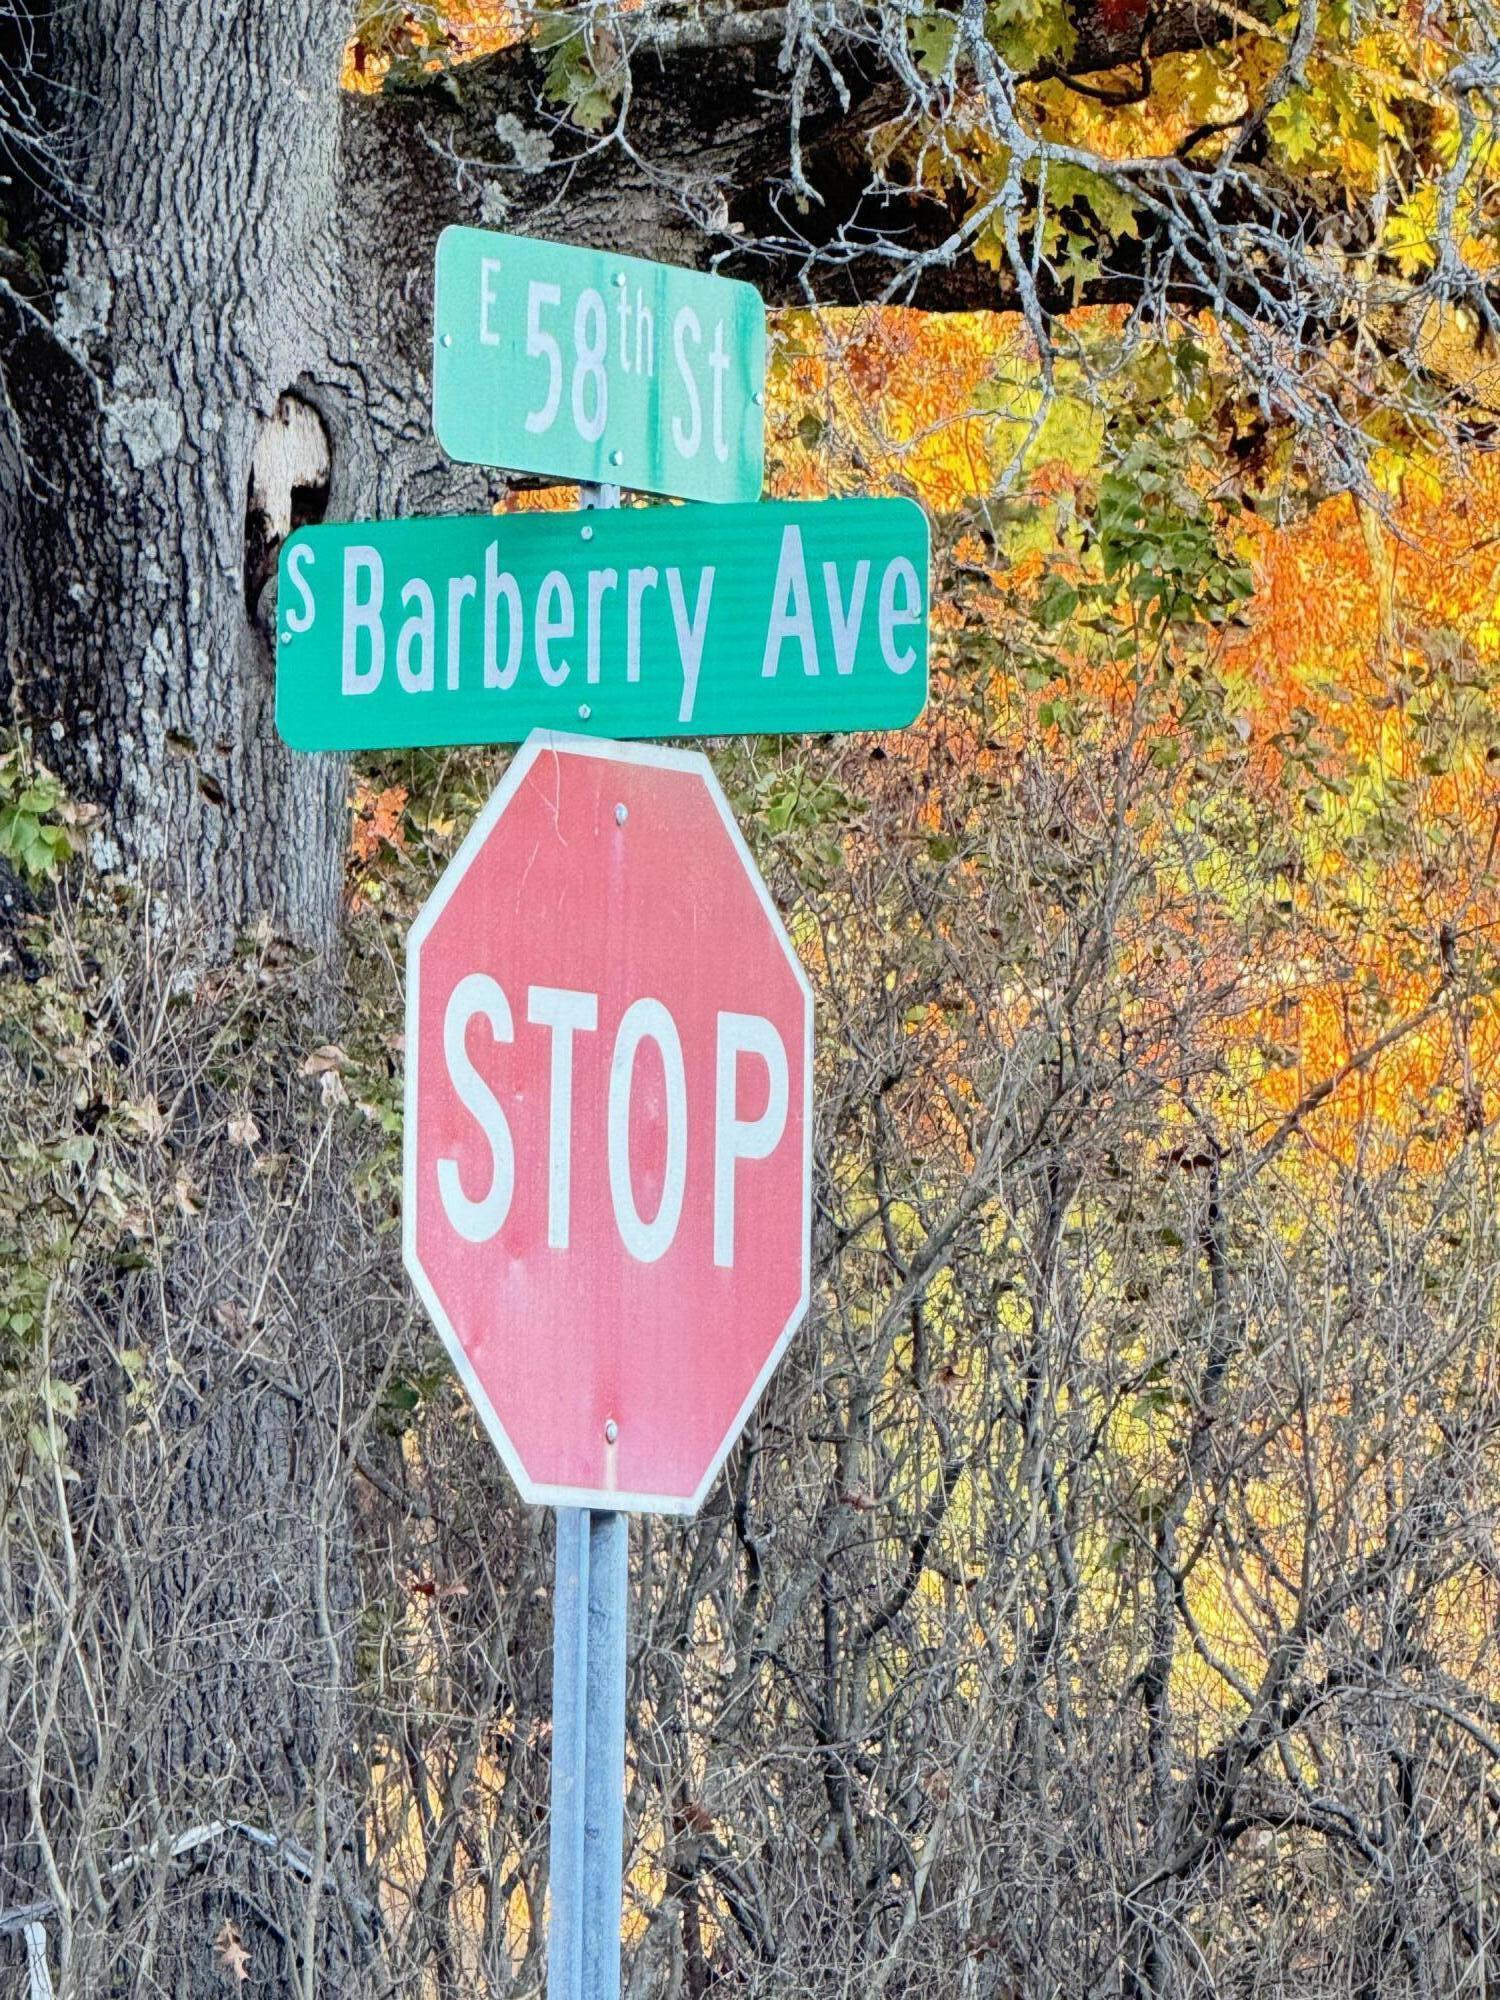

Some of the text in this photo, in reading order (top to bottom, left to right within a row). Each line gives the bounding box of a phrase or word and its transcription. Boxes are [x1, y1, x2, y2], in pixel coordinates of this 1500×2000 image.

[480, 257, 731, 464] E 58th St
[285, 524, 921, 722] S Barberry Ave
[437, 972, 790, 1268] STOP
